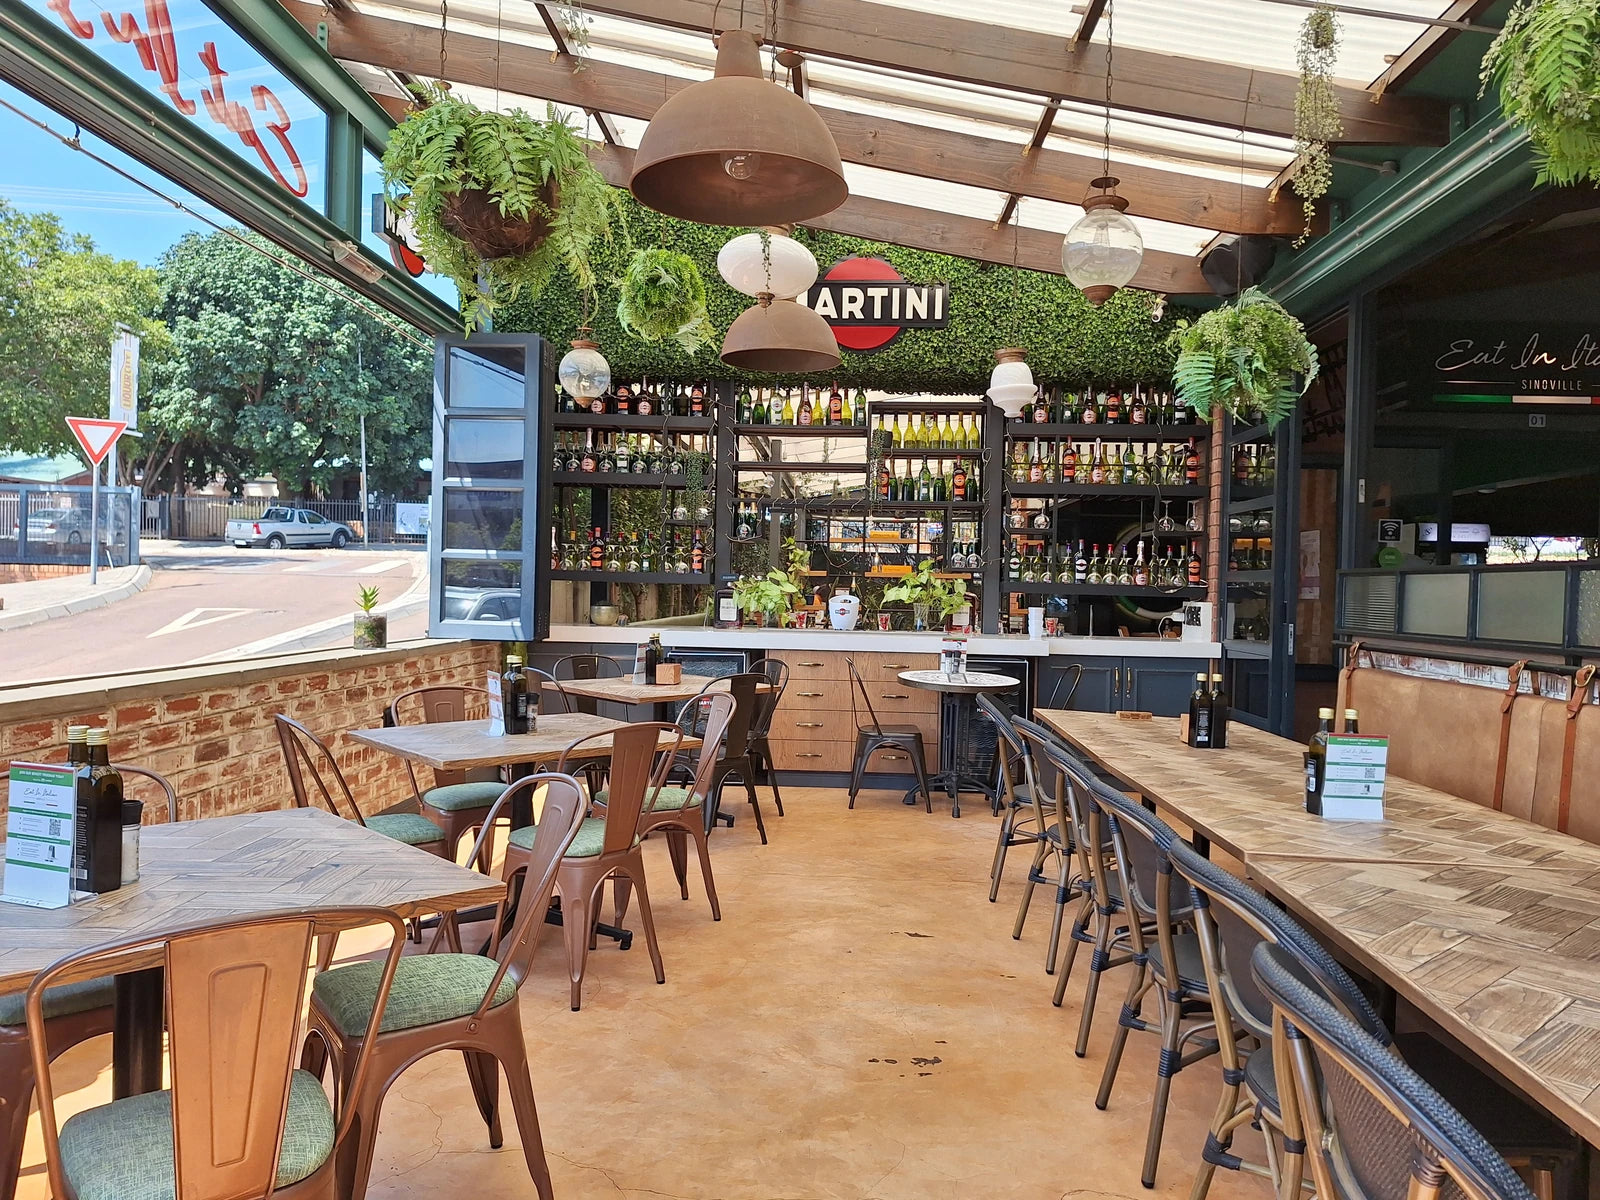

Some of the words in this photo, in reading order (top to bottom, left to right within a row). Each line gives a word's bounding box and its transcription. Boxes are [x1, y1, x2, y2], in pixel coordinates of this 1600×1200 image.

[1435, 339, 1507, 371] Eat
[1511, 333, 1557, 370] In
[1521, 379, 1582, 391] SINOVILLE
[1530, 415, 1544, 425] 01
